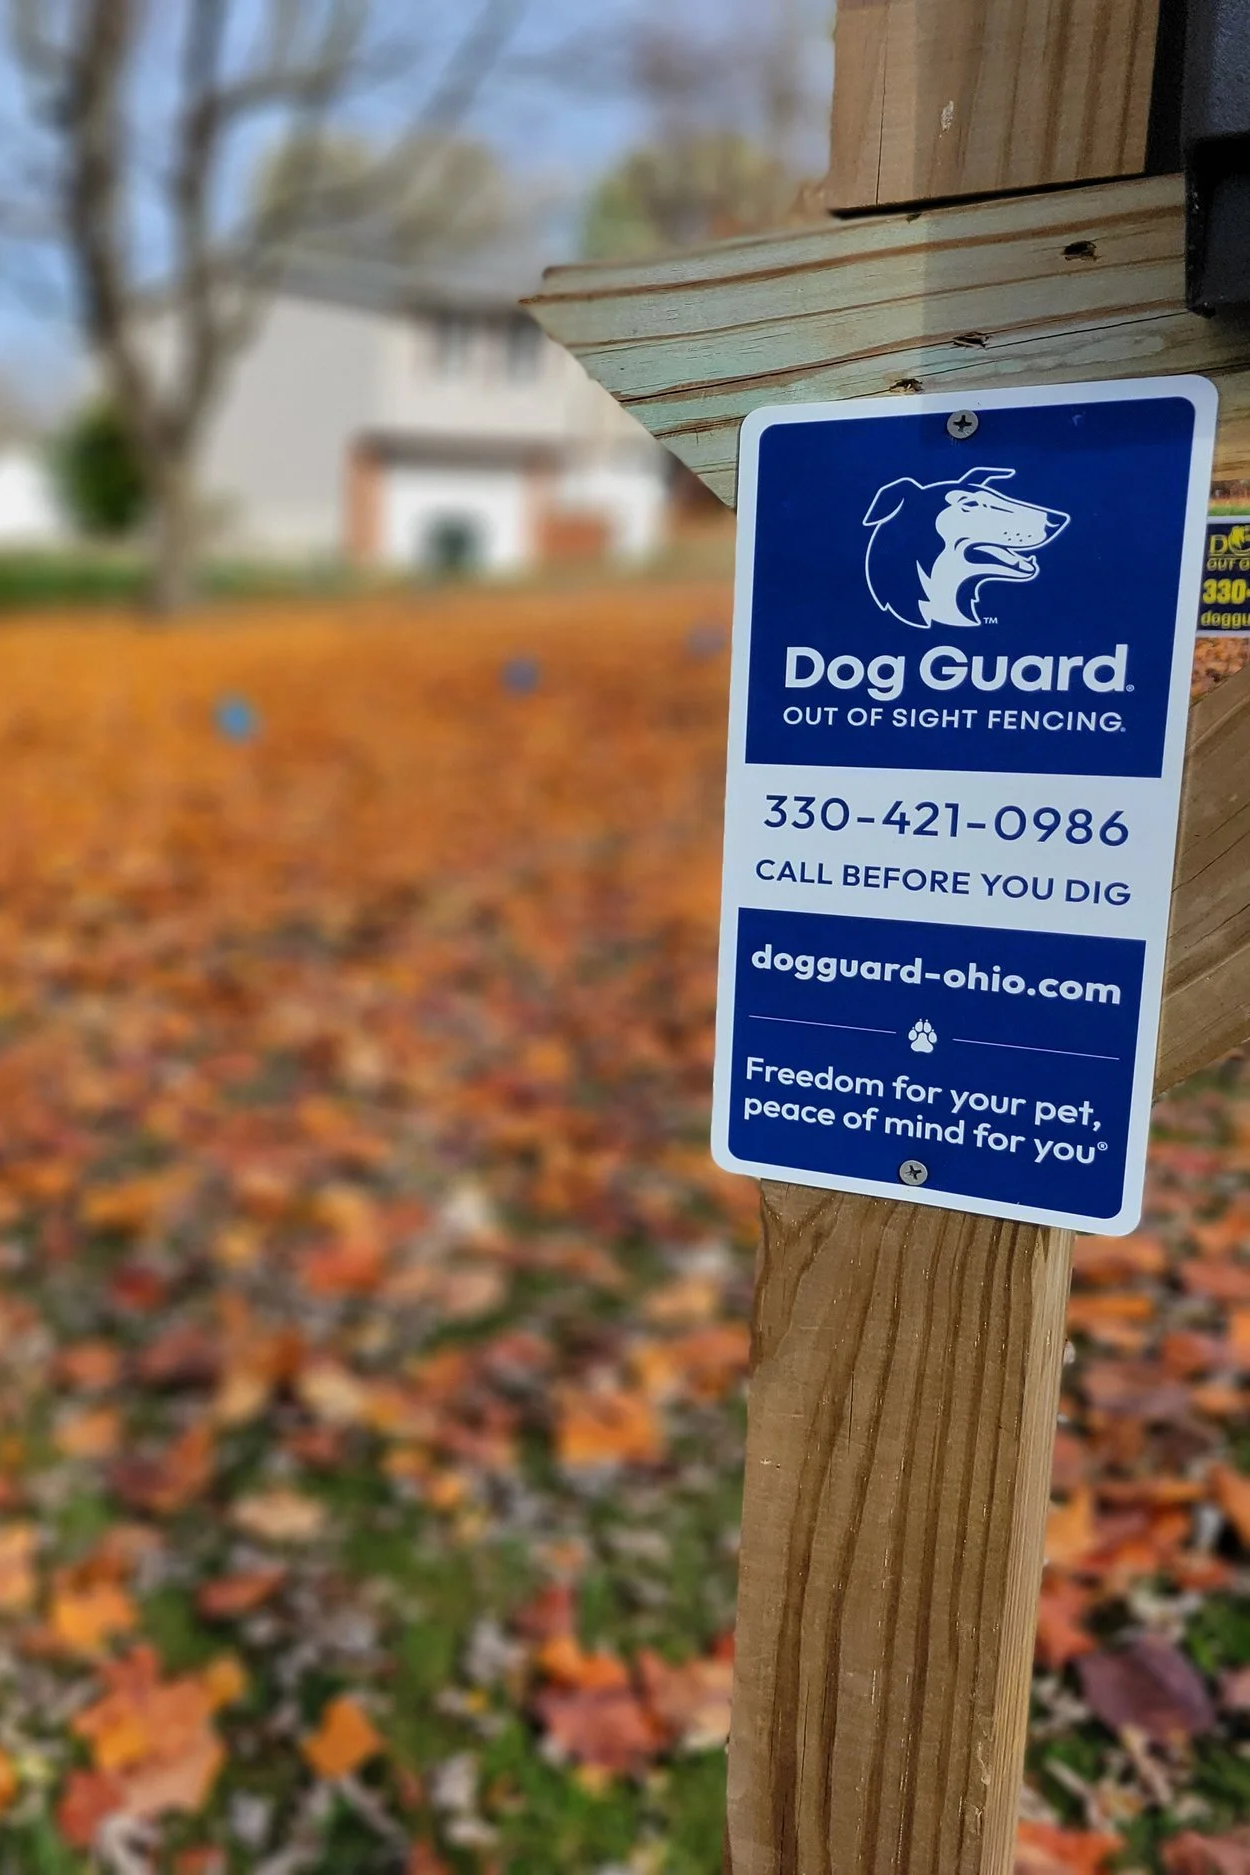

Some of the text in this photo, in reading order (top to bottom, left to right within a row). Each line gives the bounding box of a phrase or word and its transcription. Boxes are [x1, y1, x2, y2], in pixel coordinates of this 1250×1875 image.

[785, 646, 906, 701] Dog
[783, 706, 838, 725] OUT
[848, 707, 883, 727] OF
[892, 708, 978, 729] SIGHT
[763, 794, 1129, 847] 330-421-0986
[755, 859, 1131, 906] CALL BEFORE YOU DIG
[751, 944, 1121, 1005] dogguard-ohio.com
[746, 1056, 1102, 1132] Freedom for your pet,
[744, 1097, 836, 1126] peace
[842, 1107, 880, 1131] of
[884, 1114, 965, 1145] mind
[972, 1122, 1026, 1153] for
